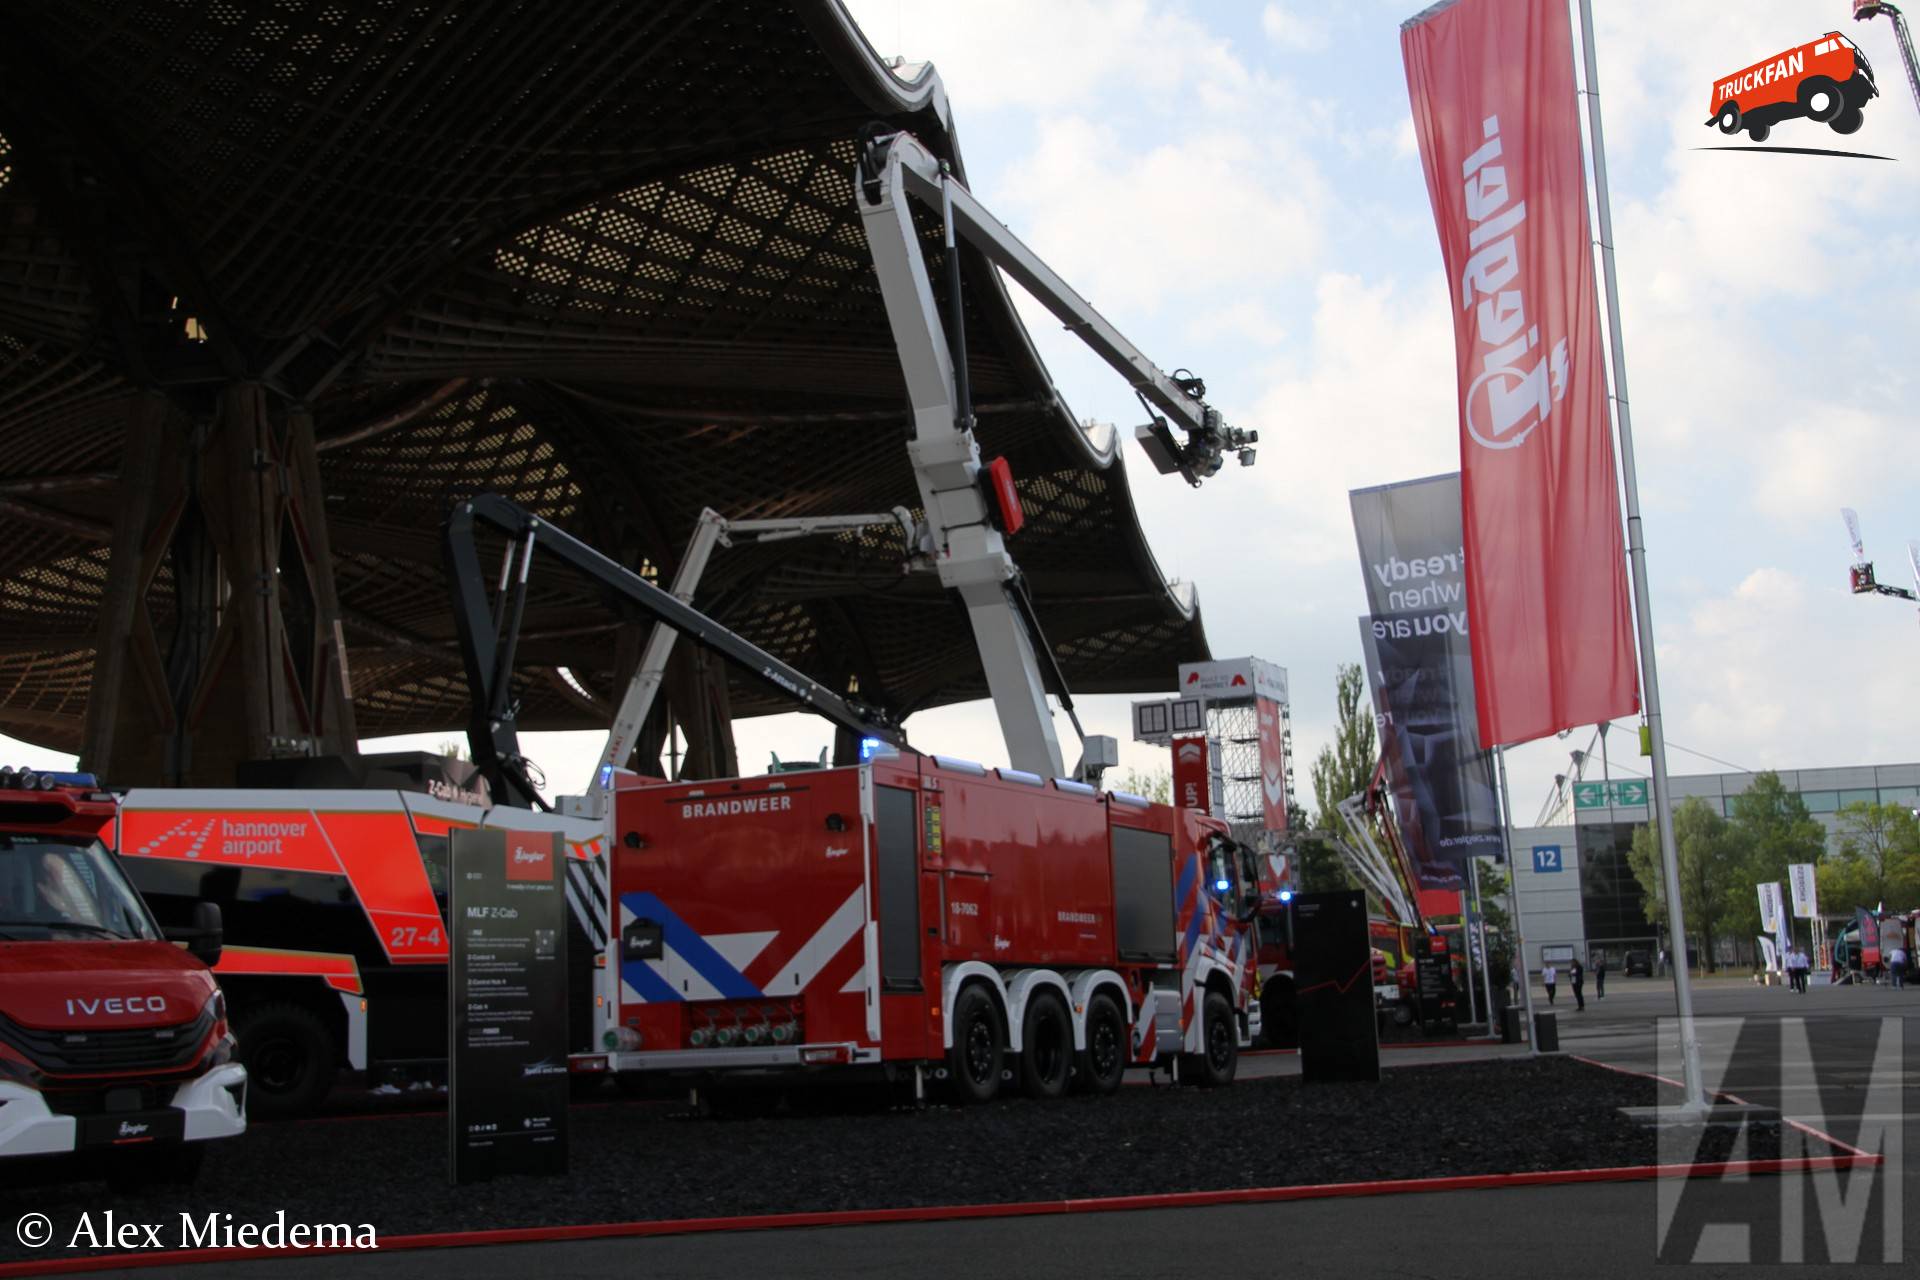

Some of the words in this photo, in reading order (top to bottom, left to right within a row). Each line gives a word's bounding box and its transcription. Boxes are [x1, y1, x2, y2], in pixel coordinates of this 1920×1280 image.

[682, 796, 791, 818] BRANDWEER
[222, 819, 307, 838] hannover
[222, 837, 283, 858] airport
[1537, 850, 1557, 867] 12
[467, 907, 489, 918] MLF
[391, 926, 440, 947] 27-4
[66, 996, 166, 1016] IVECO
